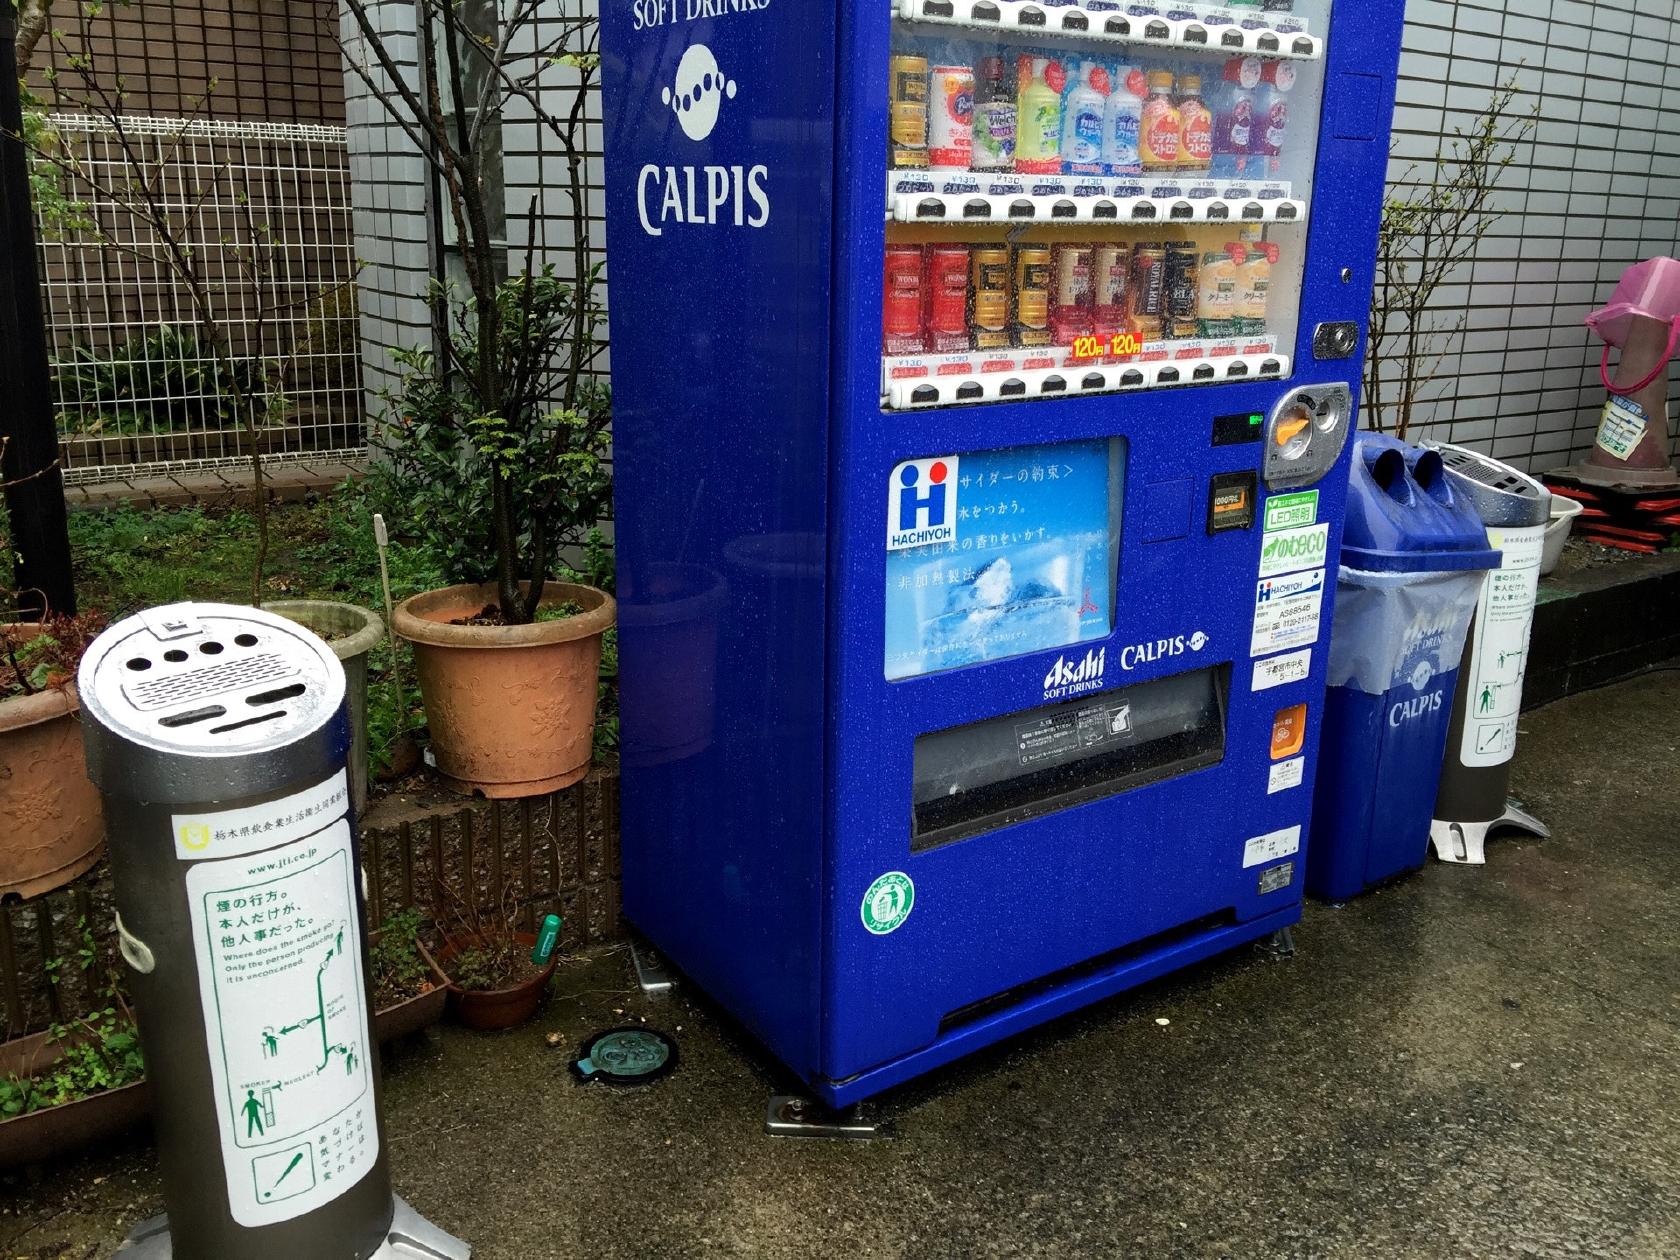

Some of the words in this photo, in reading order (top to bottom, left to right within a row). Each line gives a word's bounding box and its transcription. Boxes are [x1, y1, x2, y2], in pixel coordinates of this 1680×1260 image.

[633, 0, 678, 30] SOFT
[686, 0, 770, 20] DRI
[637, 164, 770, 236] CALPIS
[1074, 337, 1104, 357] 120円
[1111, 335, 1141, 355] 120円
[898, 359, 922, 367] ¥130
[1270, 506, 1311, 525] LED照明
[892, 528, 951, 547] HACHIYOH
[1270, 582, 1303, 594] HACHIYOH
[1120, 635, 1184, 670] CALPIS
[1043, 646, 1106, 690] Asahi
[1043, 685, 1067, 701] SOFT
[1068, 678, 1104, 695] DRINKS
[1389, 690, 1443, 727] CALPIS
[247, 848, 317, 876] www.jti.co.jp
[216, 890, 288, 913] 煙の行方。
[219, 903, 302, 930] 本人だけが、
[220, 916, 314, 949] 他人事だった。
[223, 951, 254, 962] Where
[256, 945, 278, 956] does
[280, 940, 294, 949] the
[296, 928, 322, 943] smoke
[225, 964, 246, 973] Only
[248, 961, 263, 969] the
[265, 950, 296, 966] person
[297, 932, 335, 956] producing
